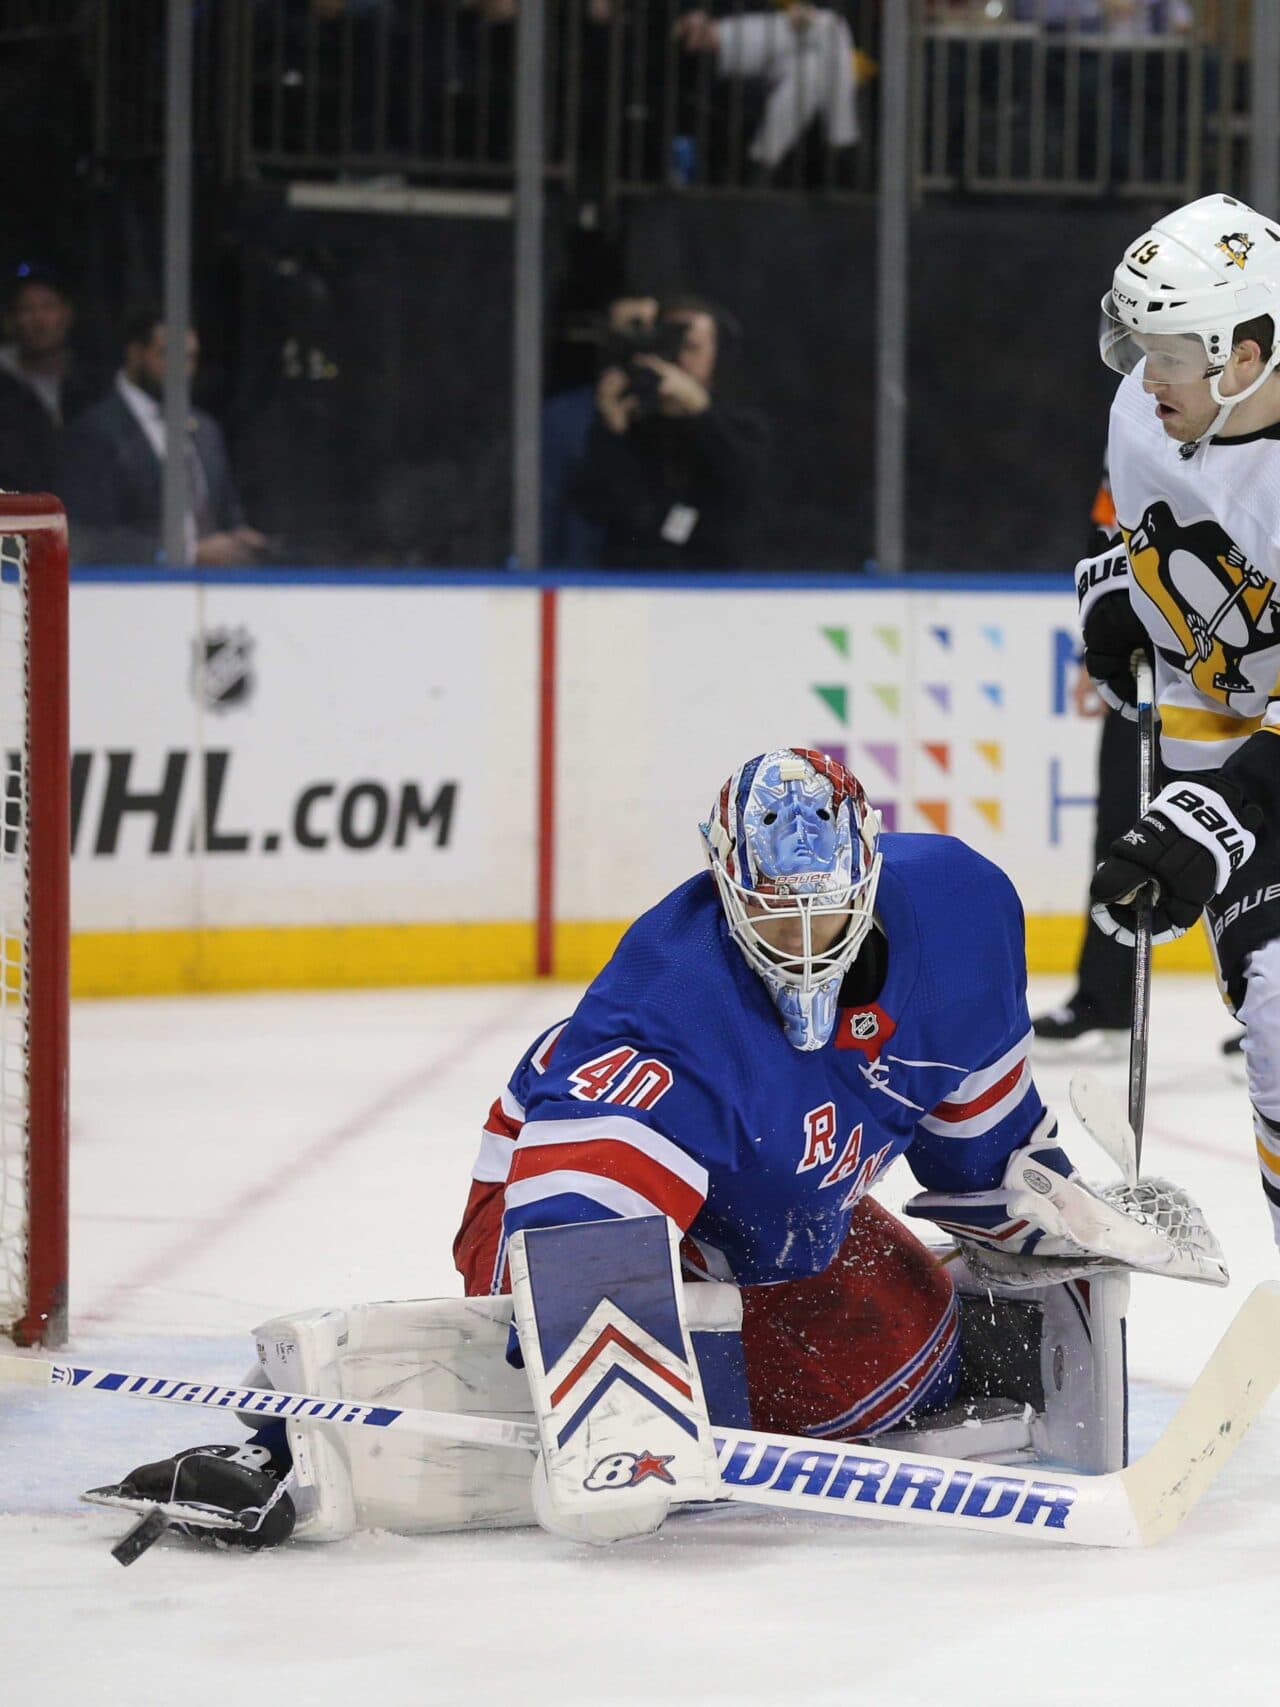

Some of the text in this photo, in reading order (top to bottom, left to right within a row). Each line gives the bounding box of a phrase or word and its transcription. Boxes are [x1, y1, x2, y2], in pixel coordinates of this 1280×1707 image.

[1131, 240, 1160, 265] 19
[1113, 287, 1138, 308] CCM
[1167, 789, 1247, 870] BAUE
[775, 873, 832, 885] BAUER
[566, 1045, 674, 1111] 40
[118, 1375, 373, 1425] WARRIOR
[712, 1438, 1078, 1529] WARRIOR
